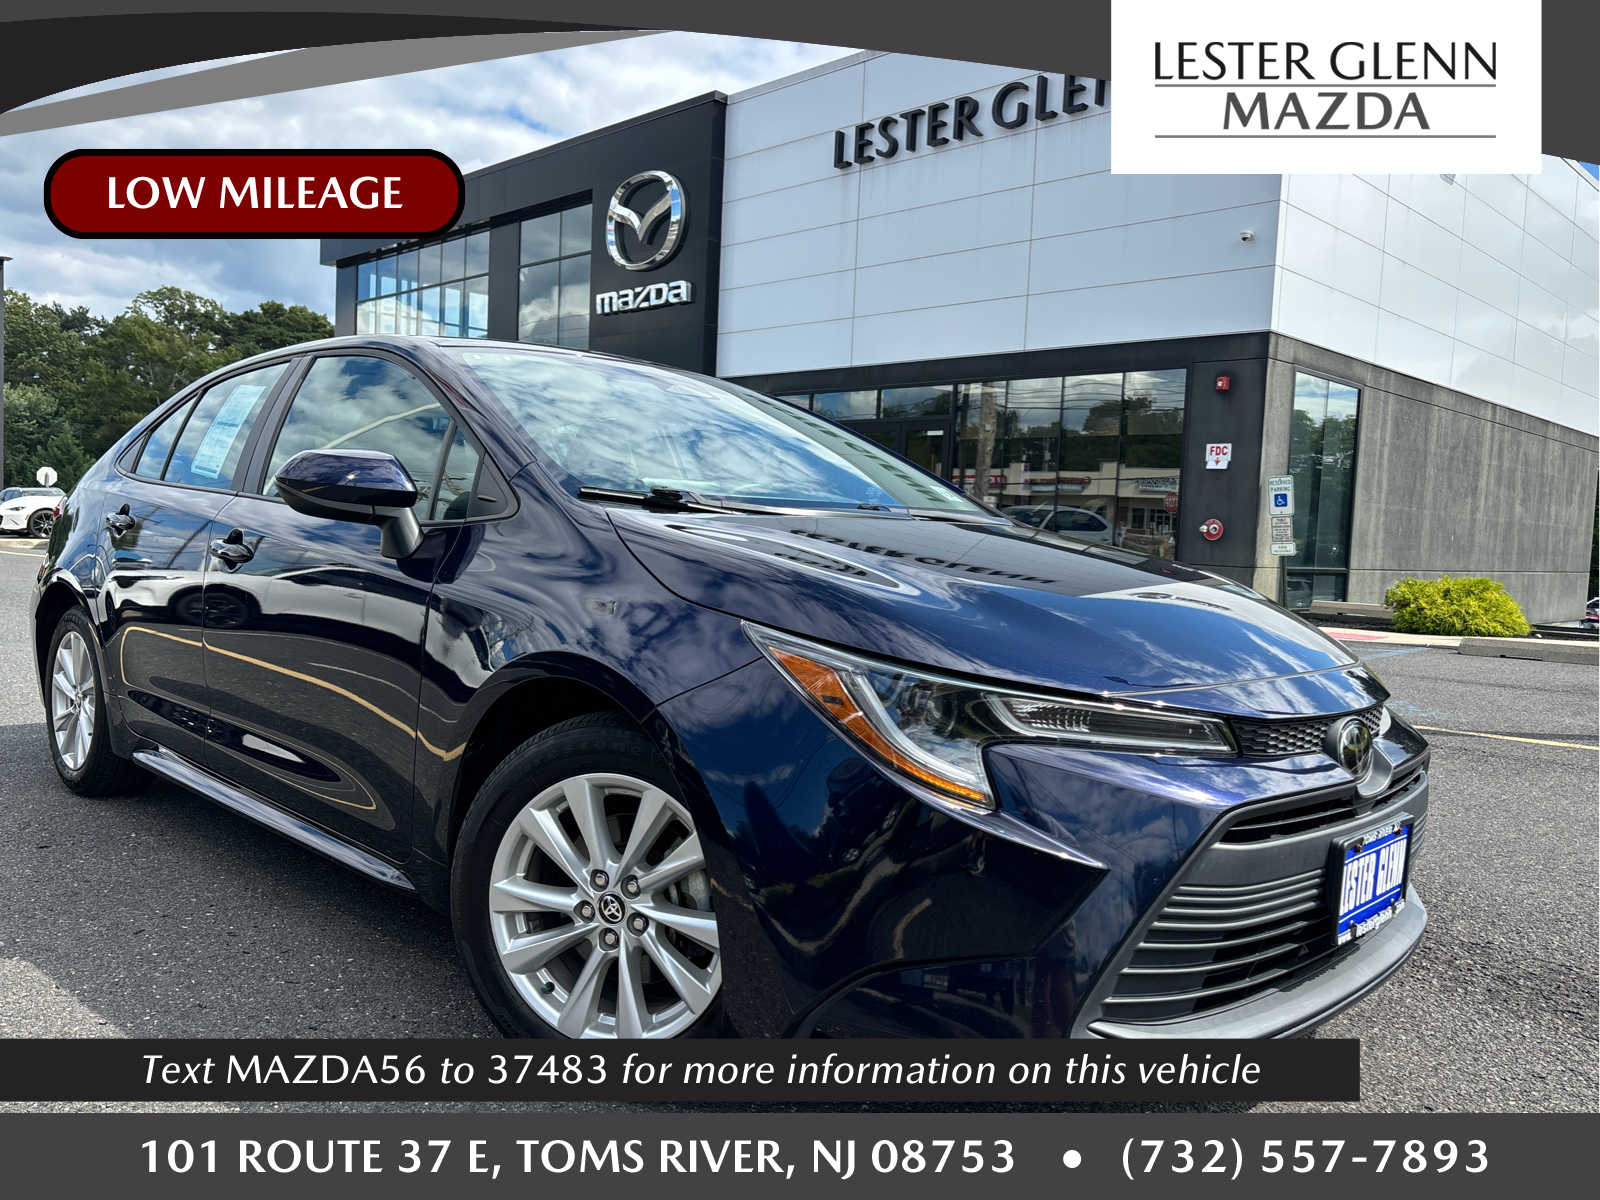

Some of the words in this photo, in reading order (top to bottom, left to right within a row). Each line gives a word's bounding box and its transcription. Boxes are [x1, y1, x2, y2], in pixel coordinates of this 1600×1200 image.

[834, 96, 984, 170] LESTER
[1209, 446, 1228, 456] FDC
[1339, 852, 1377, 916] LESTER
[1375, 838, 1407, 897] GLENN
